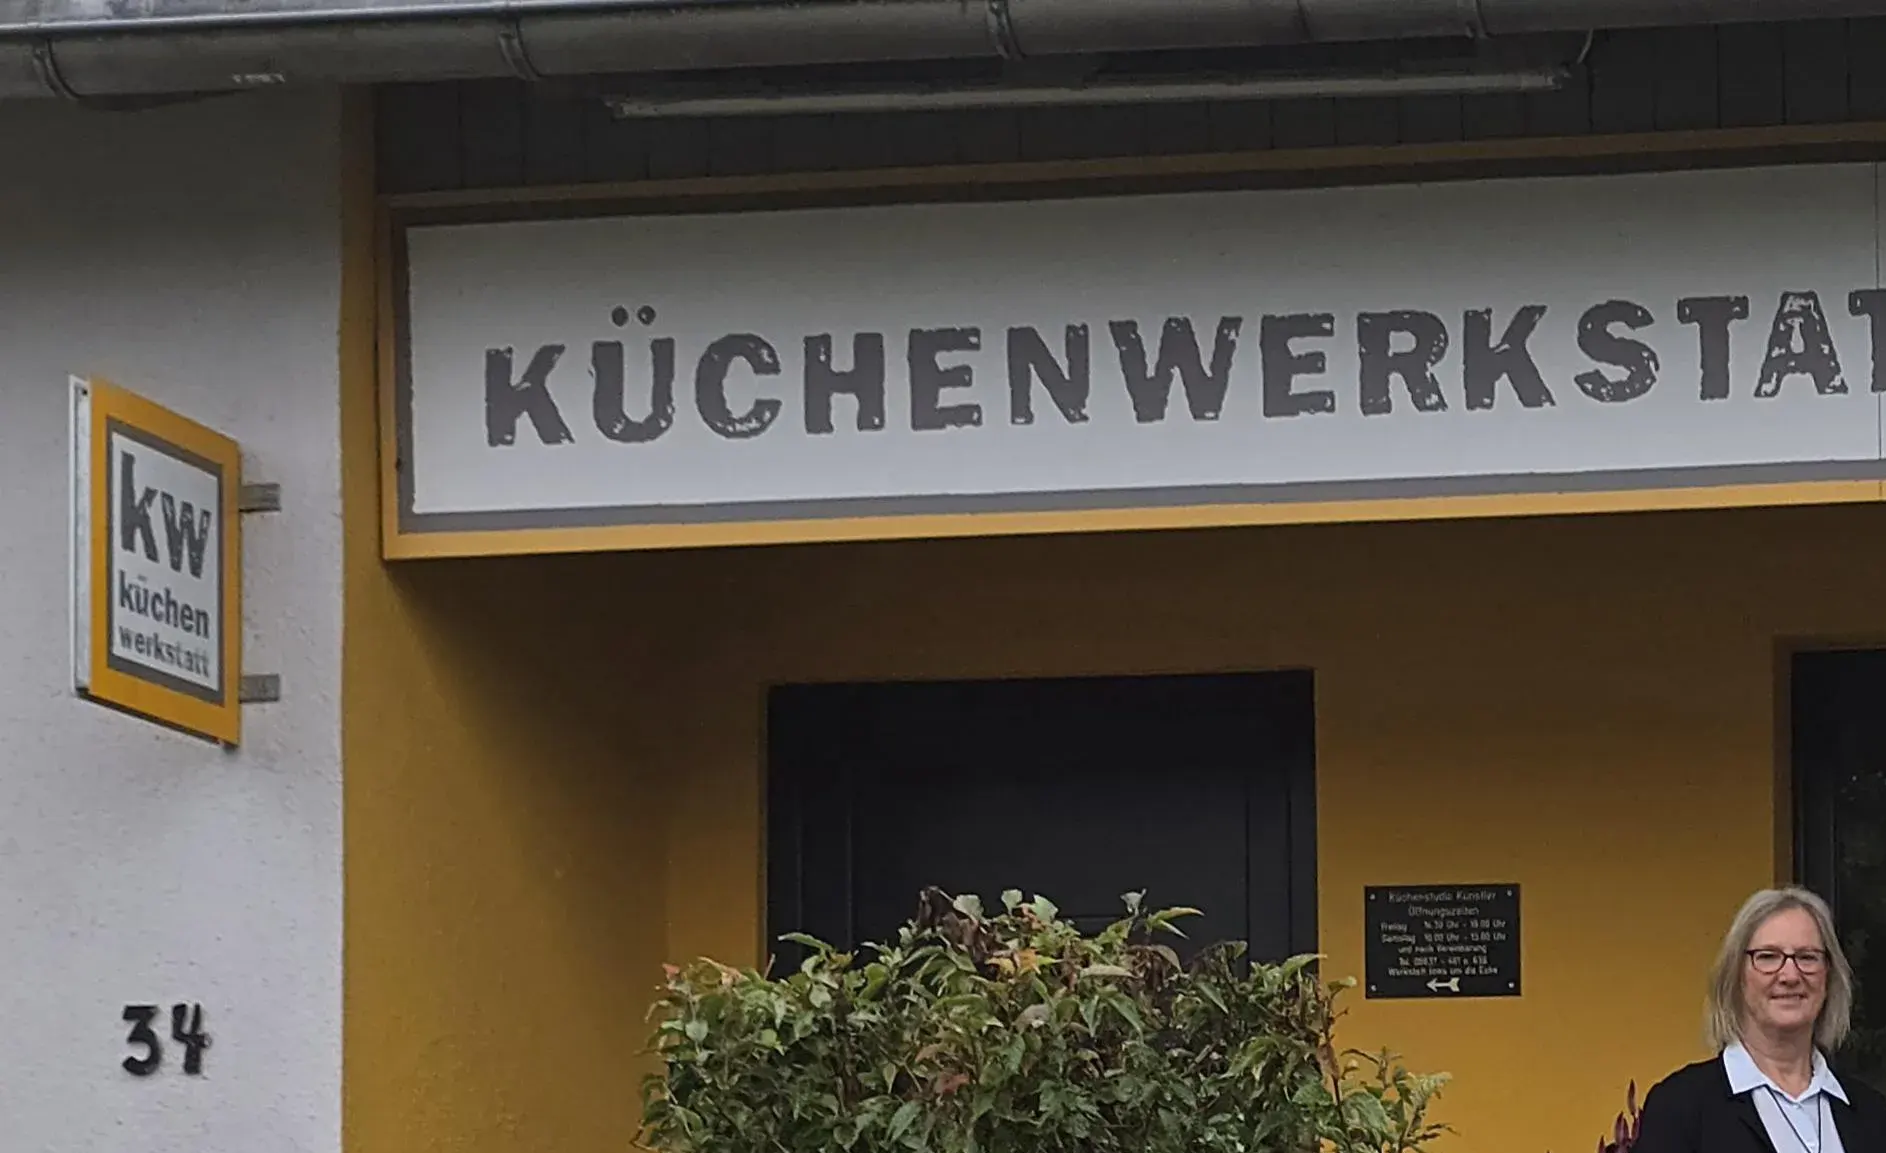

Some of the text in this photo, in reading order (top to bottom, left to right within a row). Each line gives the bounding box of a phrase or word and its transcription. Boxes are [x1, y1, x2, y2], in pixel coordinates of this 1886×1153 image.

[119, 569, 211, 640] küchen
[118, 623, 211, 679] werkstatt
[122, 1003, 213, 1077] 34
